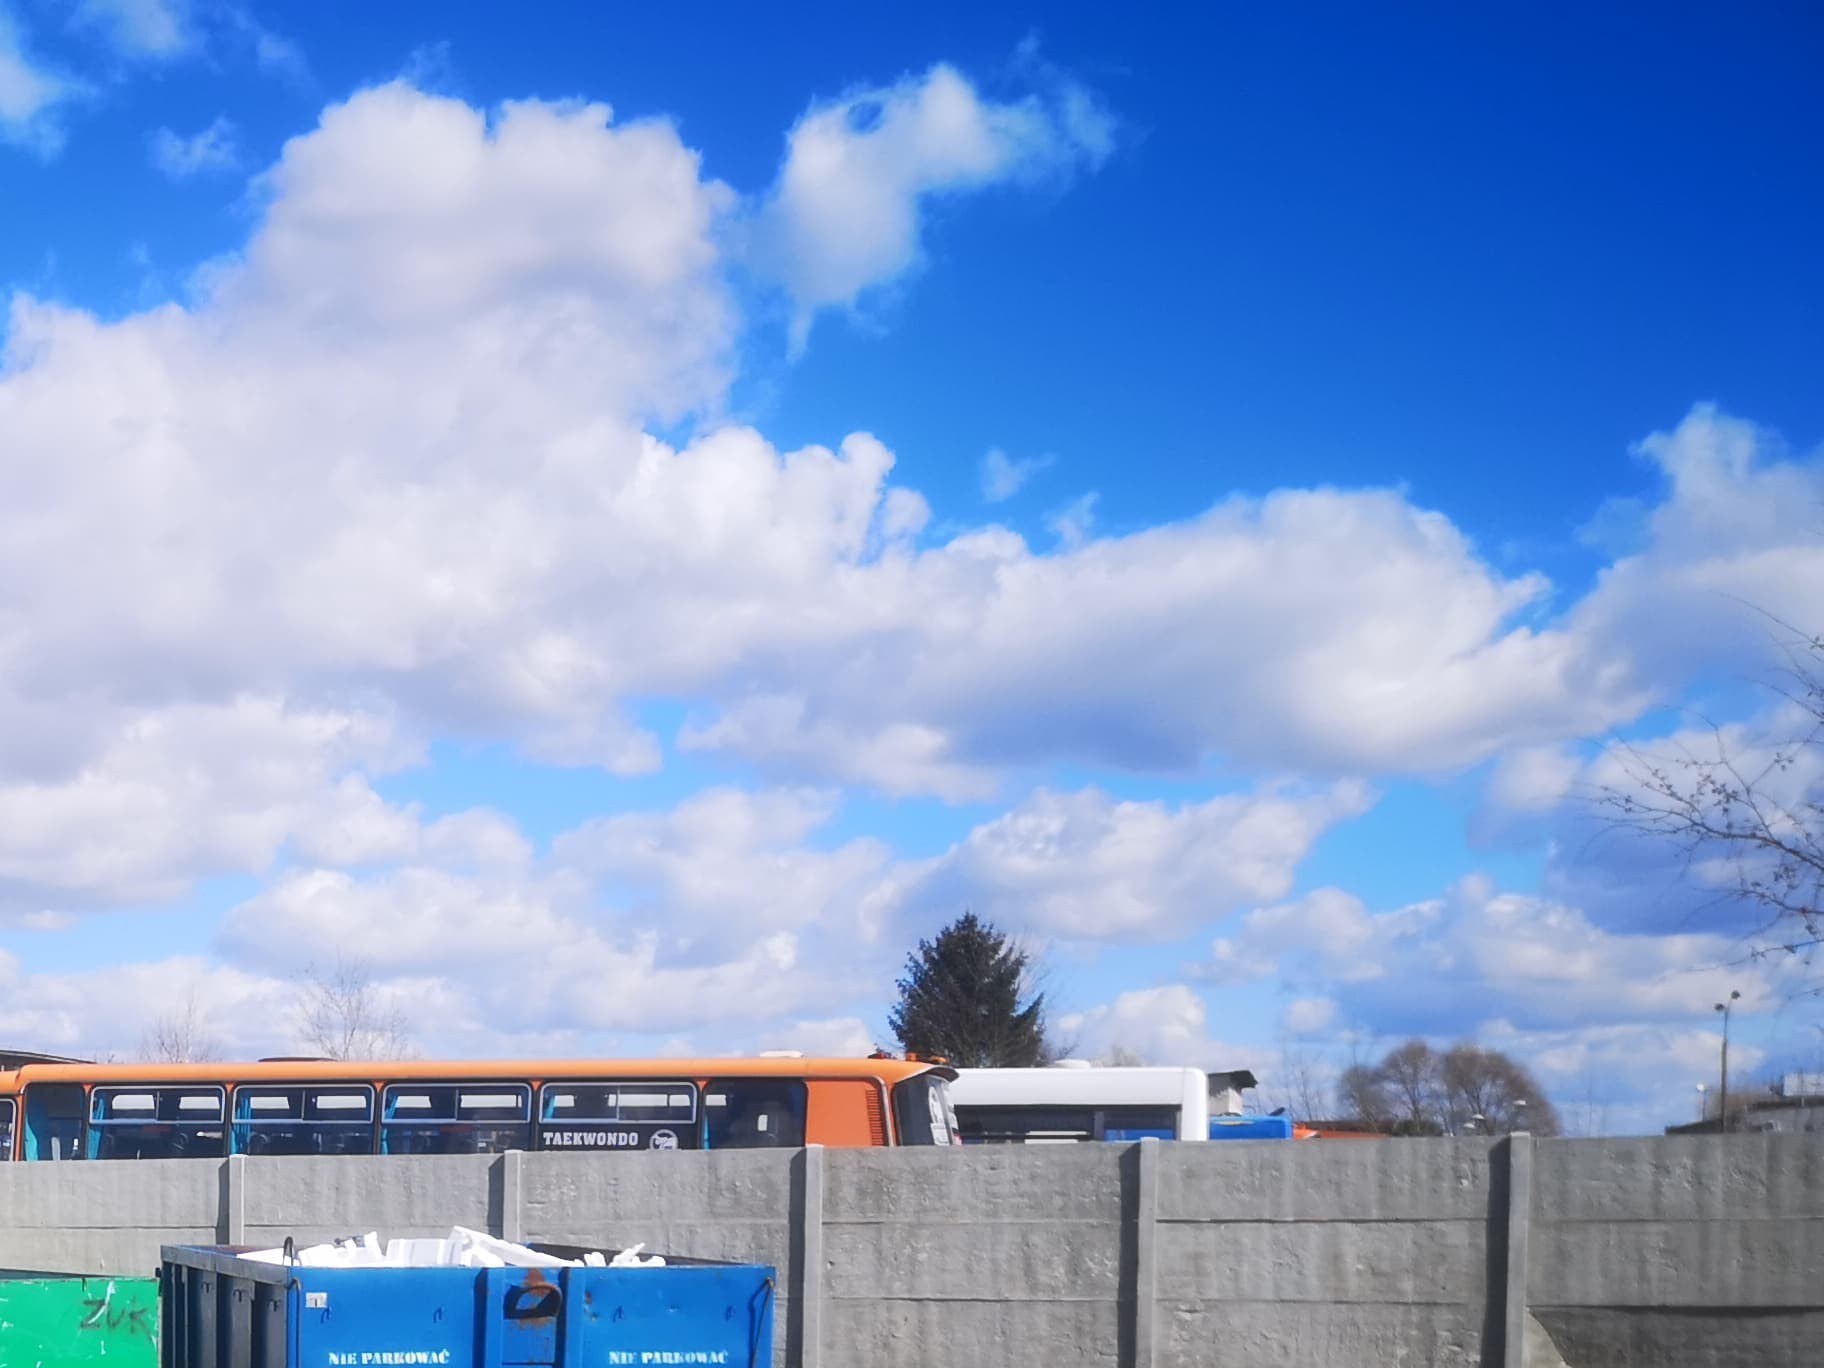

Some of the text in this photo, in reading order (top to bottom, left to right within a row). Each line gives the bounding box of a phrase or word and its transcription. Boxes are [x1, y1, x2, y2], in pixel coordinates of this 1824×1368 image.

[542, 1131, 639, 1147] TAEKWONDO
[328, 1347, 451, 1366] NIE PARKOWAĆ
